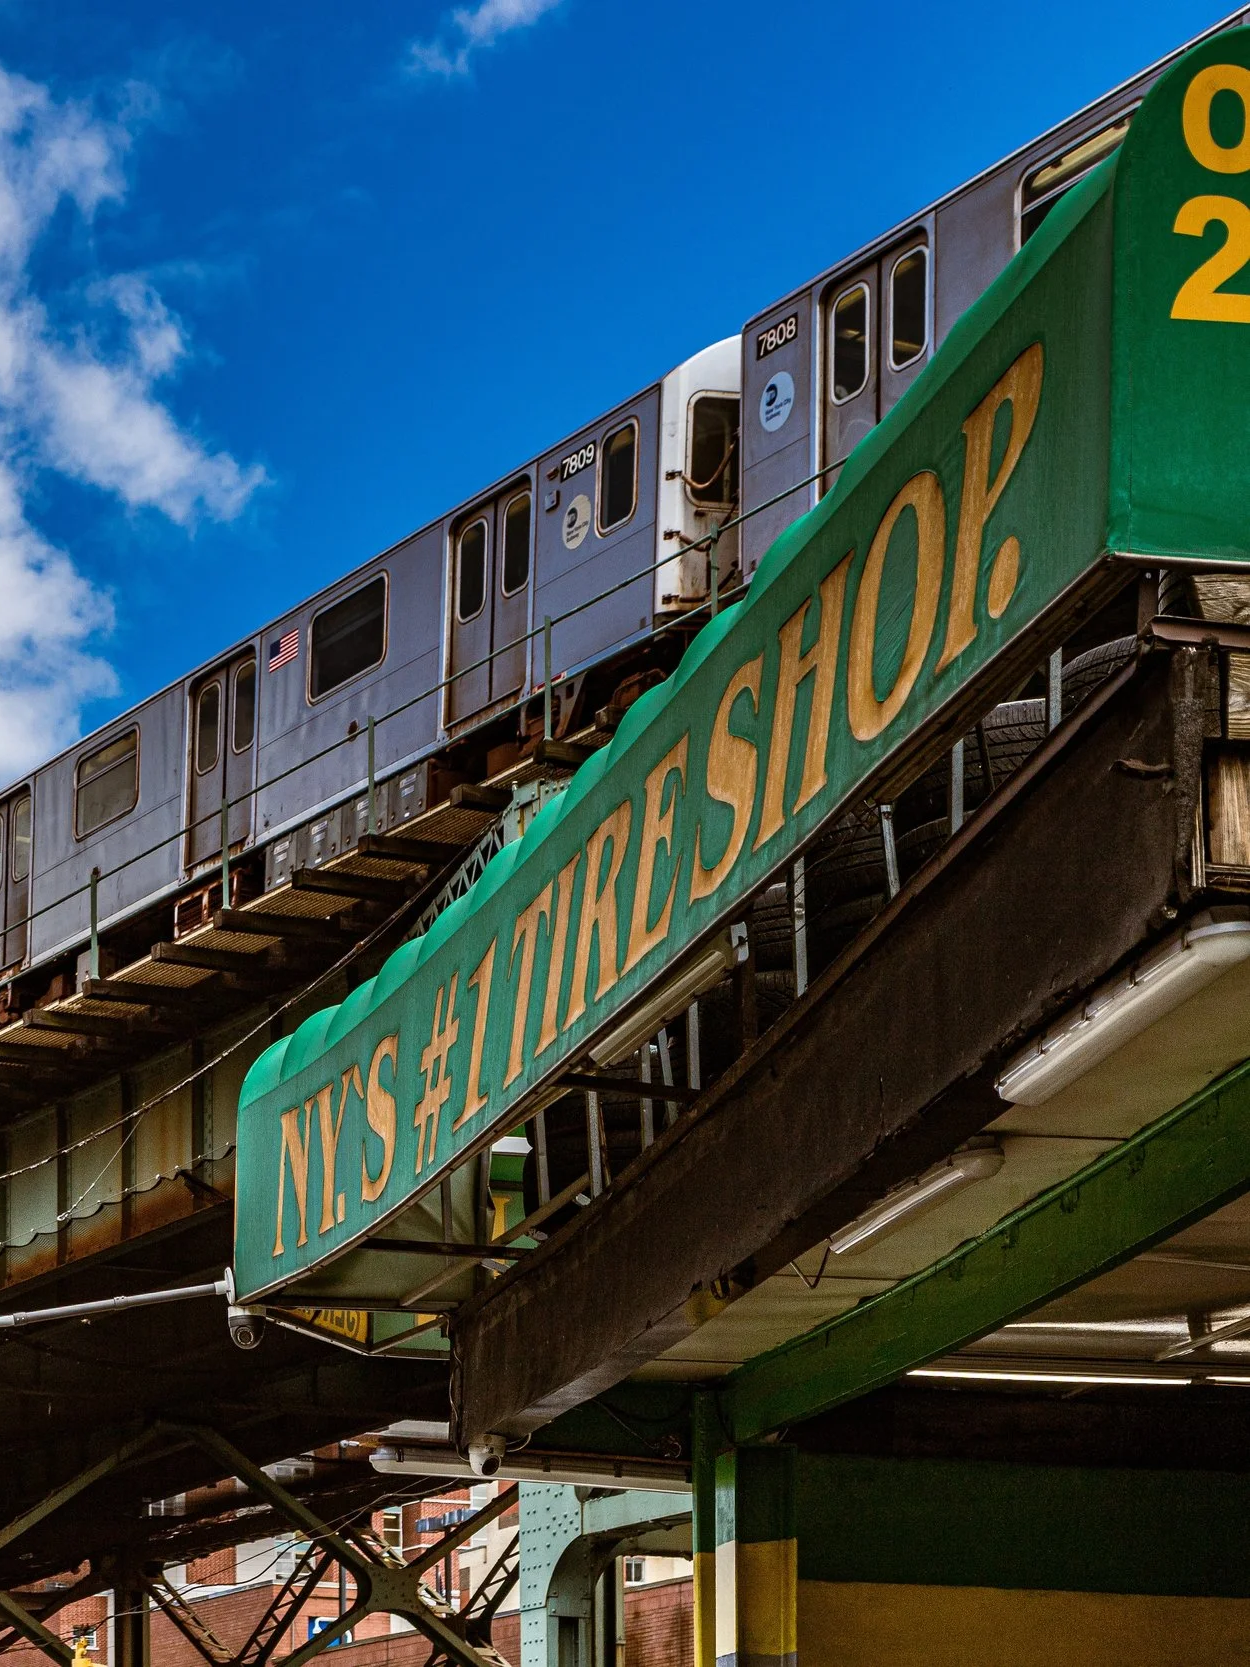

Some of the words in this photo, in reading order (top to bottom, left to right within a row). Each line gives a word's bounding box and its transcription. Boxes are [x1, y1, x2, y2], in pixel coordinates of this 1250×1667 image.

[758, 317, 796, 356] 7808
[562, 443, 595, 479] 7809
[414, 934, 496, 1175] #1
[503, 733, 689, 1090] TIRE
[688, 341, 1044, 905] SHOP.
